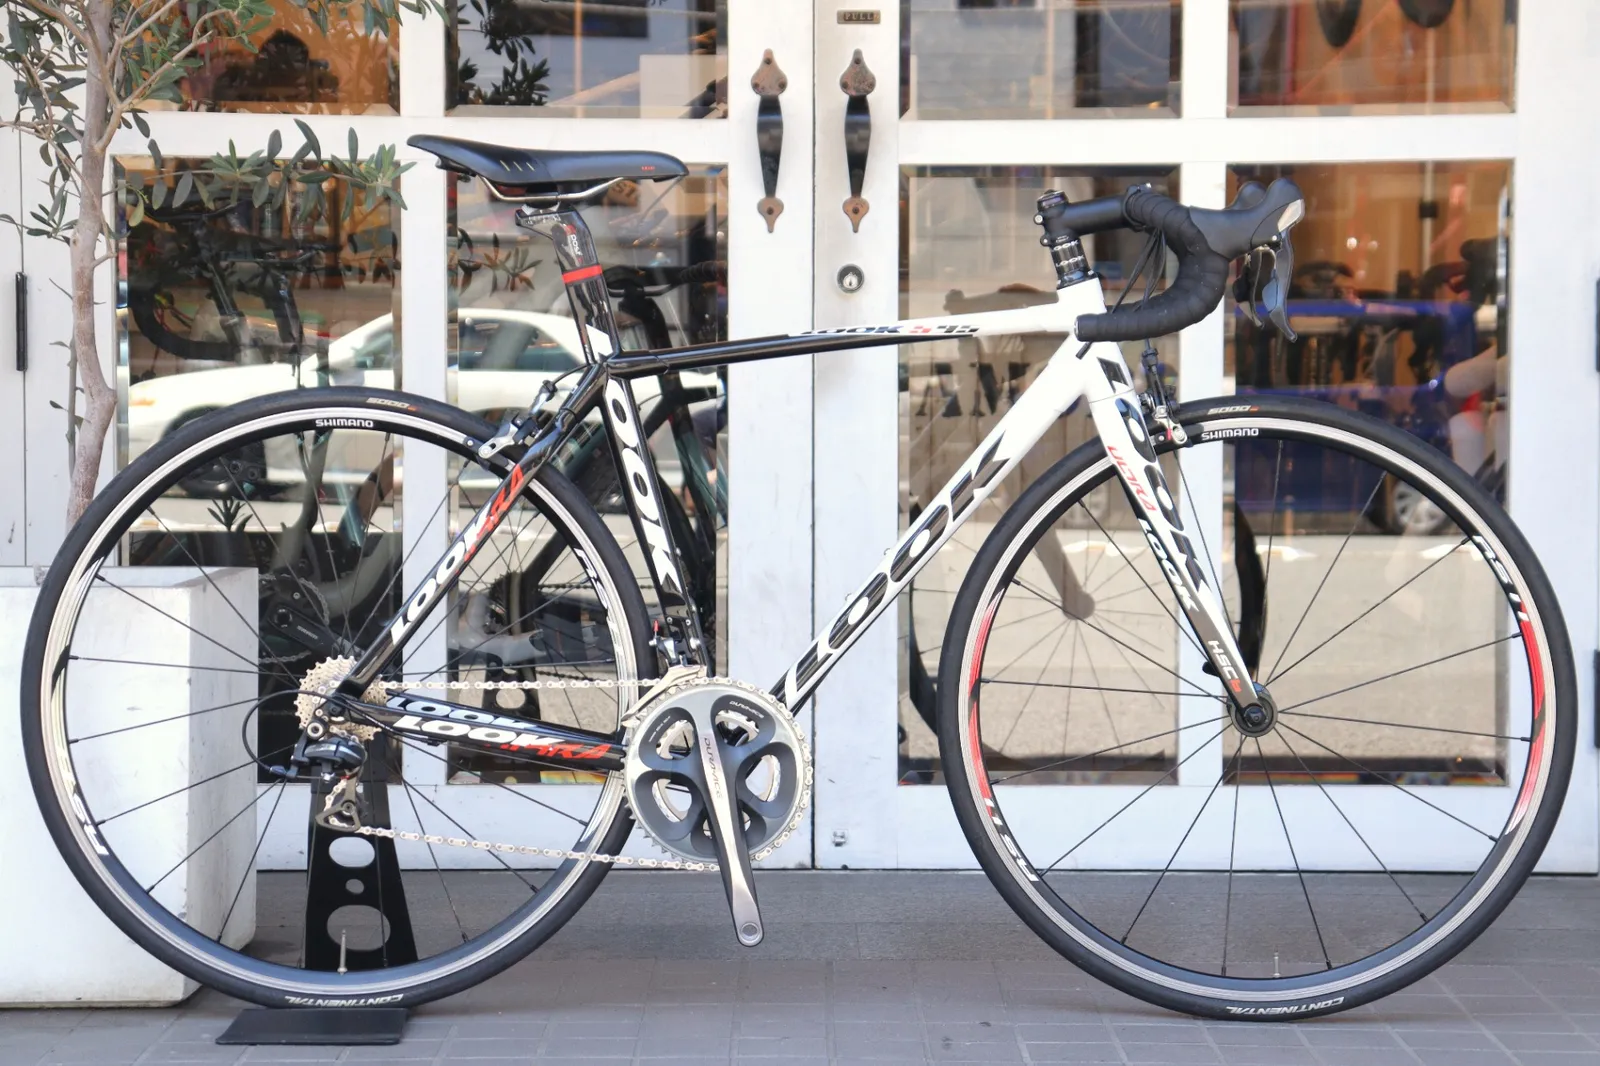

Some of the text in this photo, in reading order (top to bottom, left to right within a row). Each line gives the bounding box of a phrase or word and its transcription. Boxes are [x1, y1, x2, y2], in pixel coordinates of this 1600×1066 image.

[1058, 254, 1084, 268] LOOK
[800, 325, 904, 335] LOOK
[1207, 406, 1252, 415] 5000
[315, 418, 374, 428] SHIMANO
[1201, 428, 1259, 441] SHIMANO
[1097, 357, 1211, 593] LOOK
[1107, 445, 1157, 512] ULTRA
[795, 428, 1011, 693] LOOK
[1137, 517, 1200, 612] LOOK
[390, 502, 491, 645] LOOK
[393, 715, 565, 746] LOOK
[285, 993, 404, 1007] CONTINENTAL
[1226, 996, 1345, 1015] CONTINENTAL
